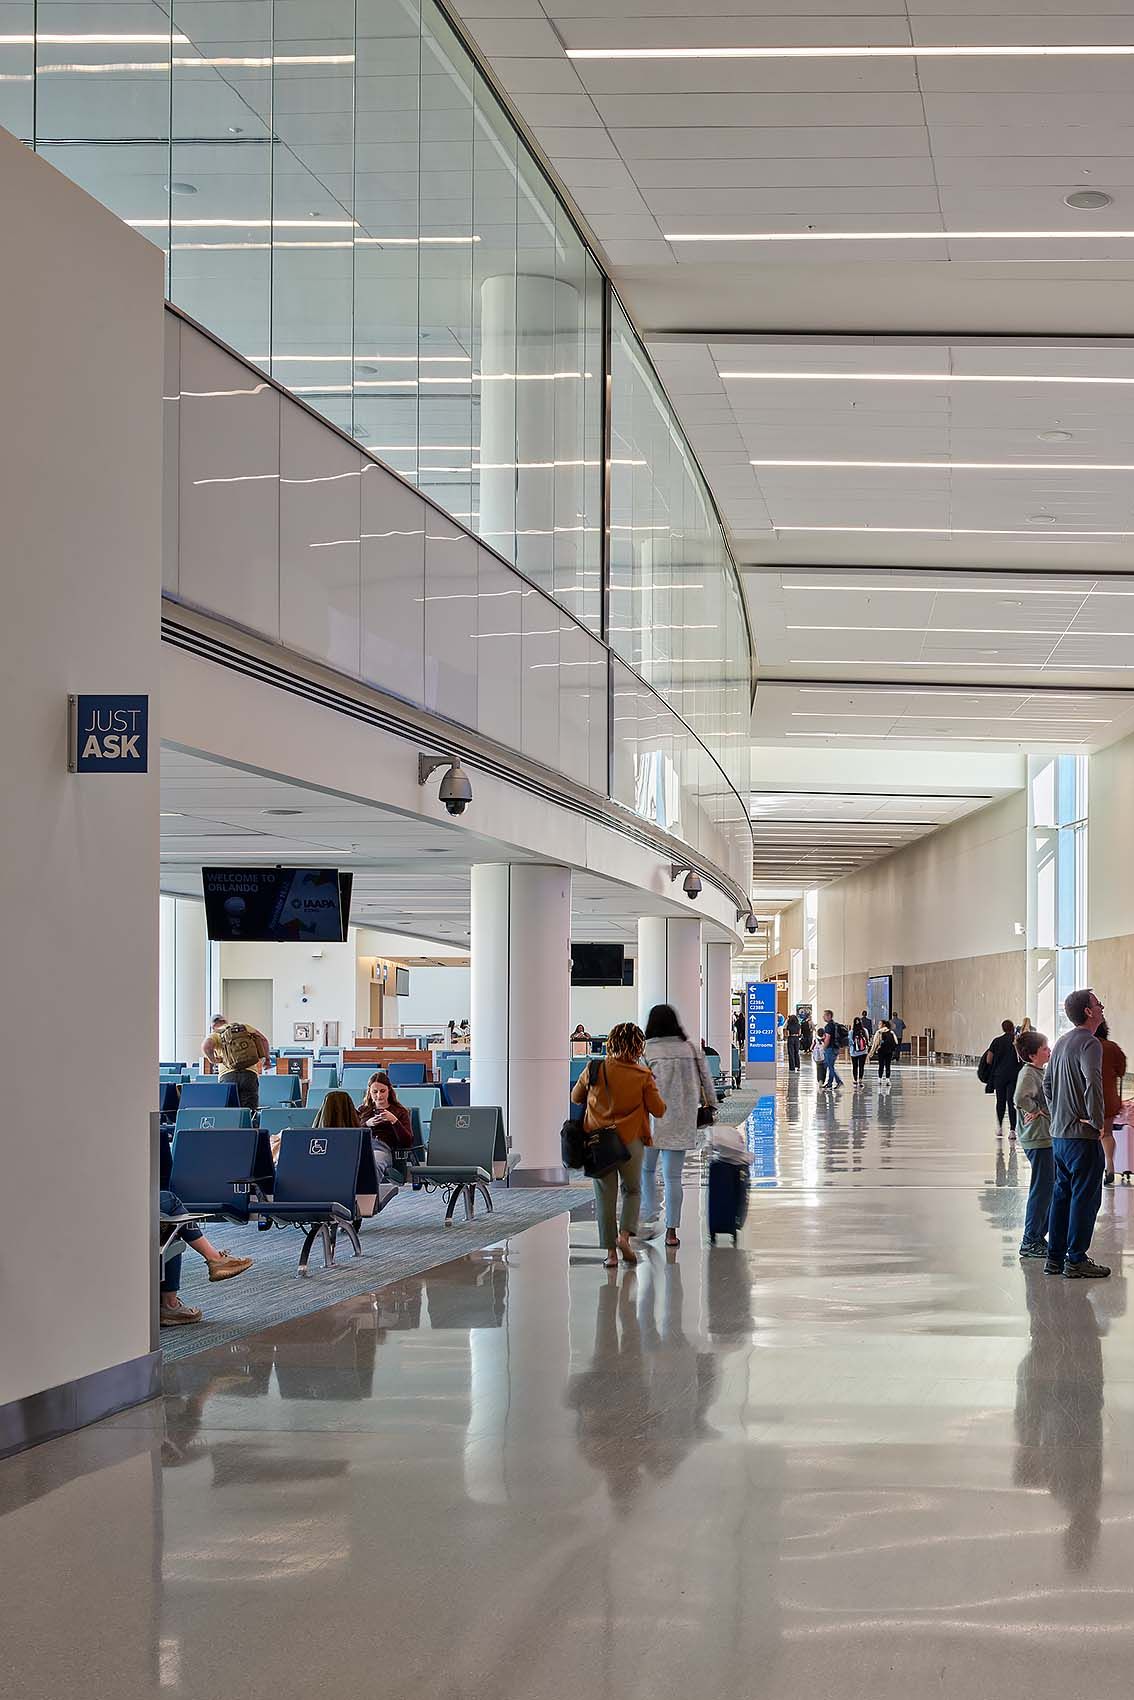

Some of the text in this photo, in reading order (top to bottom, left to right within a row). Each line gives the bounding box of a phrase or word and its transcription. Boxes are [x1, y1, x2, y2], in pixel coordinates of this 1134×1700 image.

[84, 709, 141, 732] JUST
[81, 734, 141, 759] ASK
[207, 873, 276, 882] WELCOME TO
[208, 884, 259, 892] ORLANDO
[303, 900, 336, 908] IAAPA
